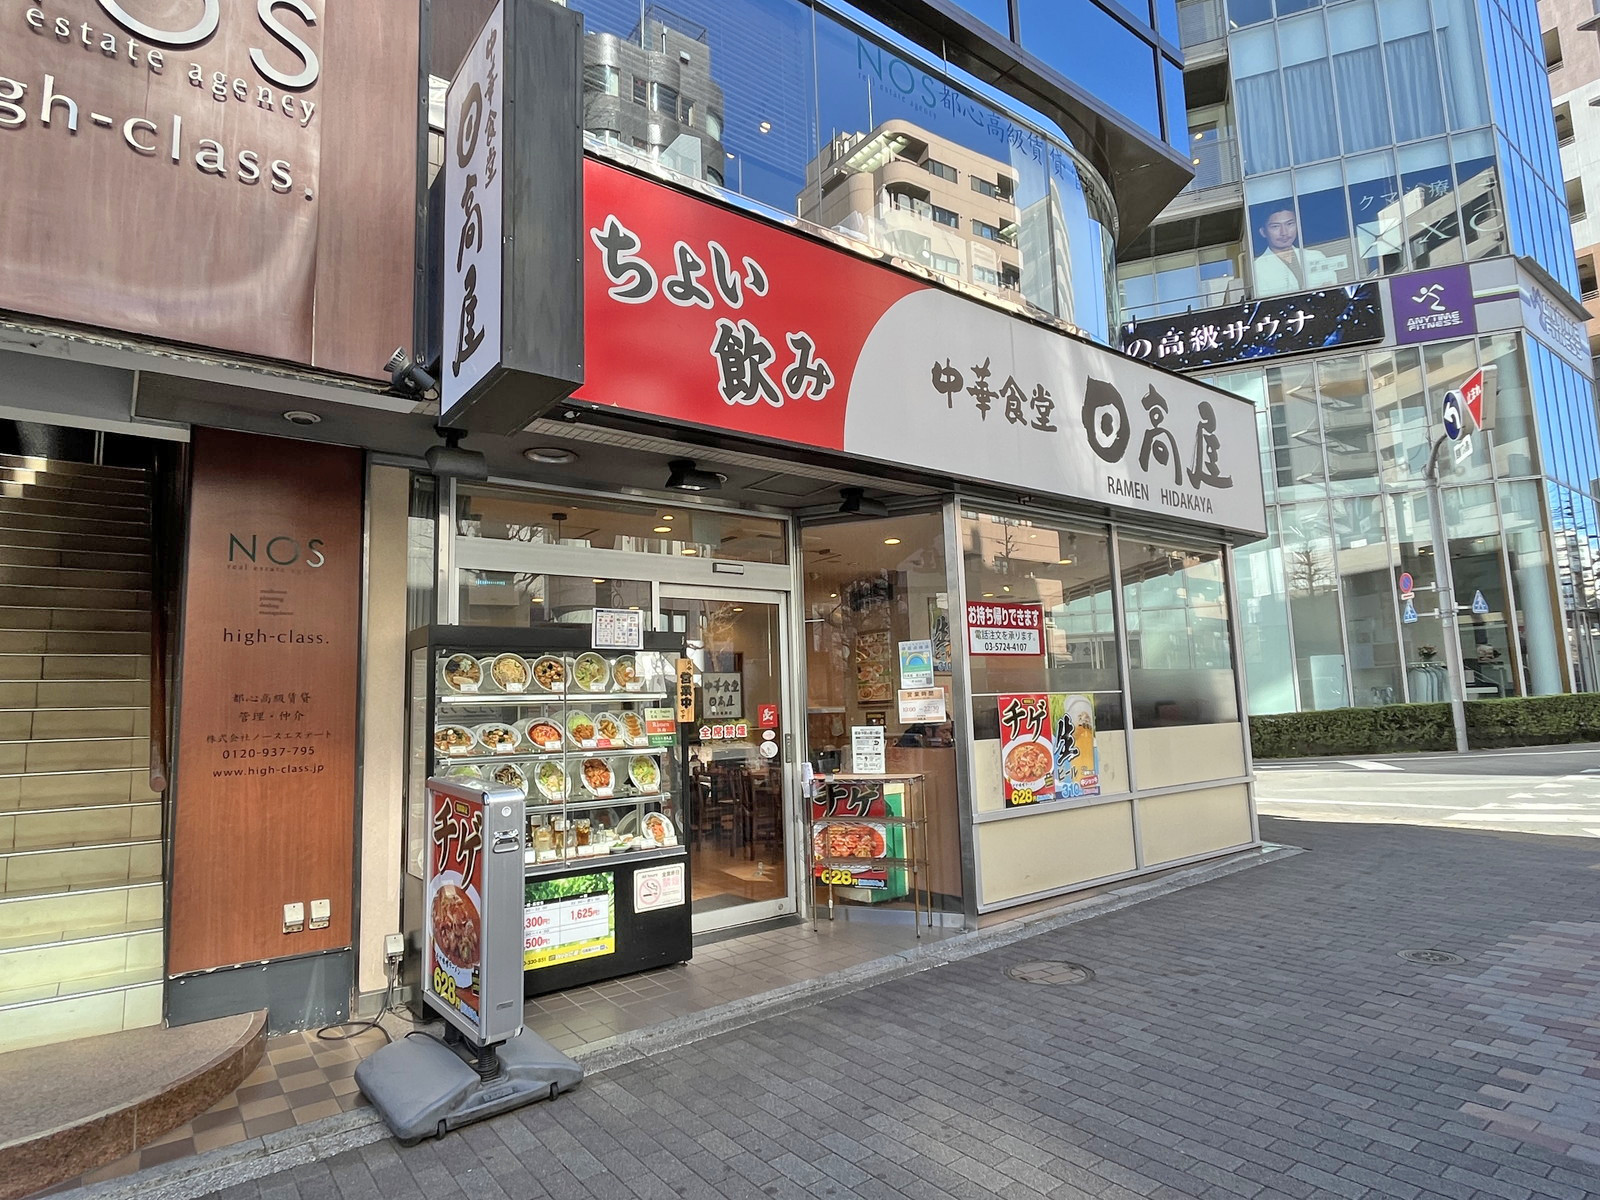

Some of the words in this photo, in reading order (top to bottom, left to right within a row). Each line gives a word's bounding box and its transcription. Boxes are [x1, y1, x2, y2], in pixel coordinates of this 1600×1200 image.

[25, 6, 164, 69] estate
[187, 62, 316, 124] agency
[856, 36, 937, 109] NOS
[484, 28, 499, 189] 中華食堂
[0, 73, 314, 197] gh-class.
[590, 213, 769, 310] ちょい
[1406, 310, 1460, 327] ANYTIME
[709, 317, 835, 408] 飲み
[931, 356, 1058, 433] 中華食堂
[1081, 374, 1233, 490] 日高屋
[1107, 476, 1149, 501] RAMEN
[1160, 488, 1213, 514] HIDAKAYA
[228, 533, 325, 568] NOS
[967, 605, 1040, 627] お持ち帰りできます
[222, 627, 330, 646] high-class.
[984, 641, 1028, 651] 03-5724-4107
[232, 692, 311, 705] 都心高級賃貸
[699, 724, 748, 740] 全席禁煙
[212, 764, 325, 779] www.high-class.jp
[222, 746, 315, 760] 0120-937-795
[432, 797, 483, 890] チゲ
